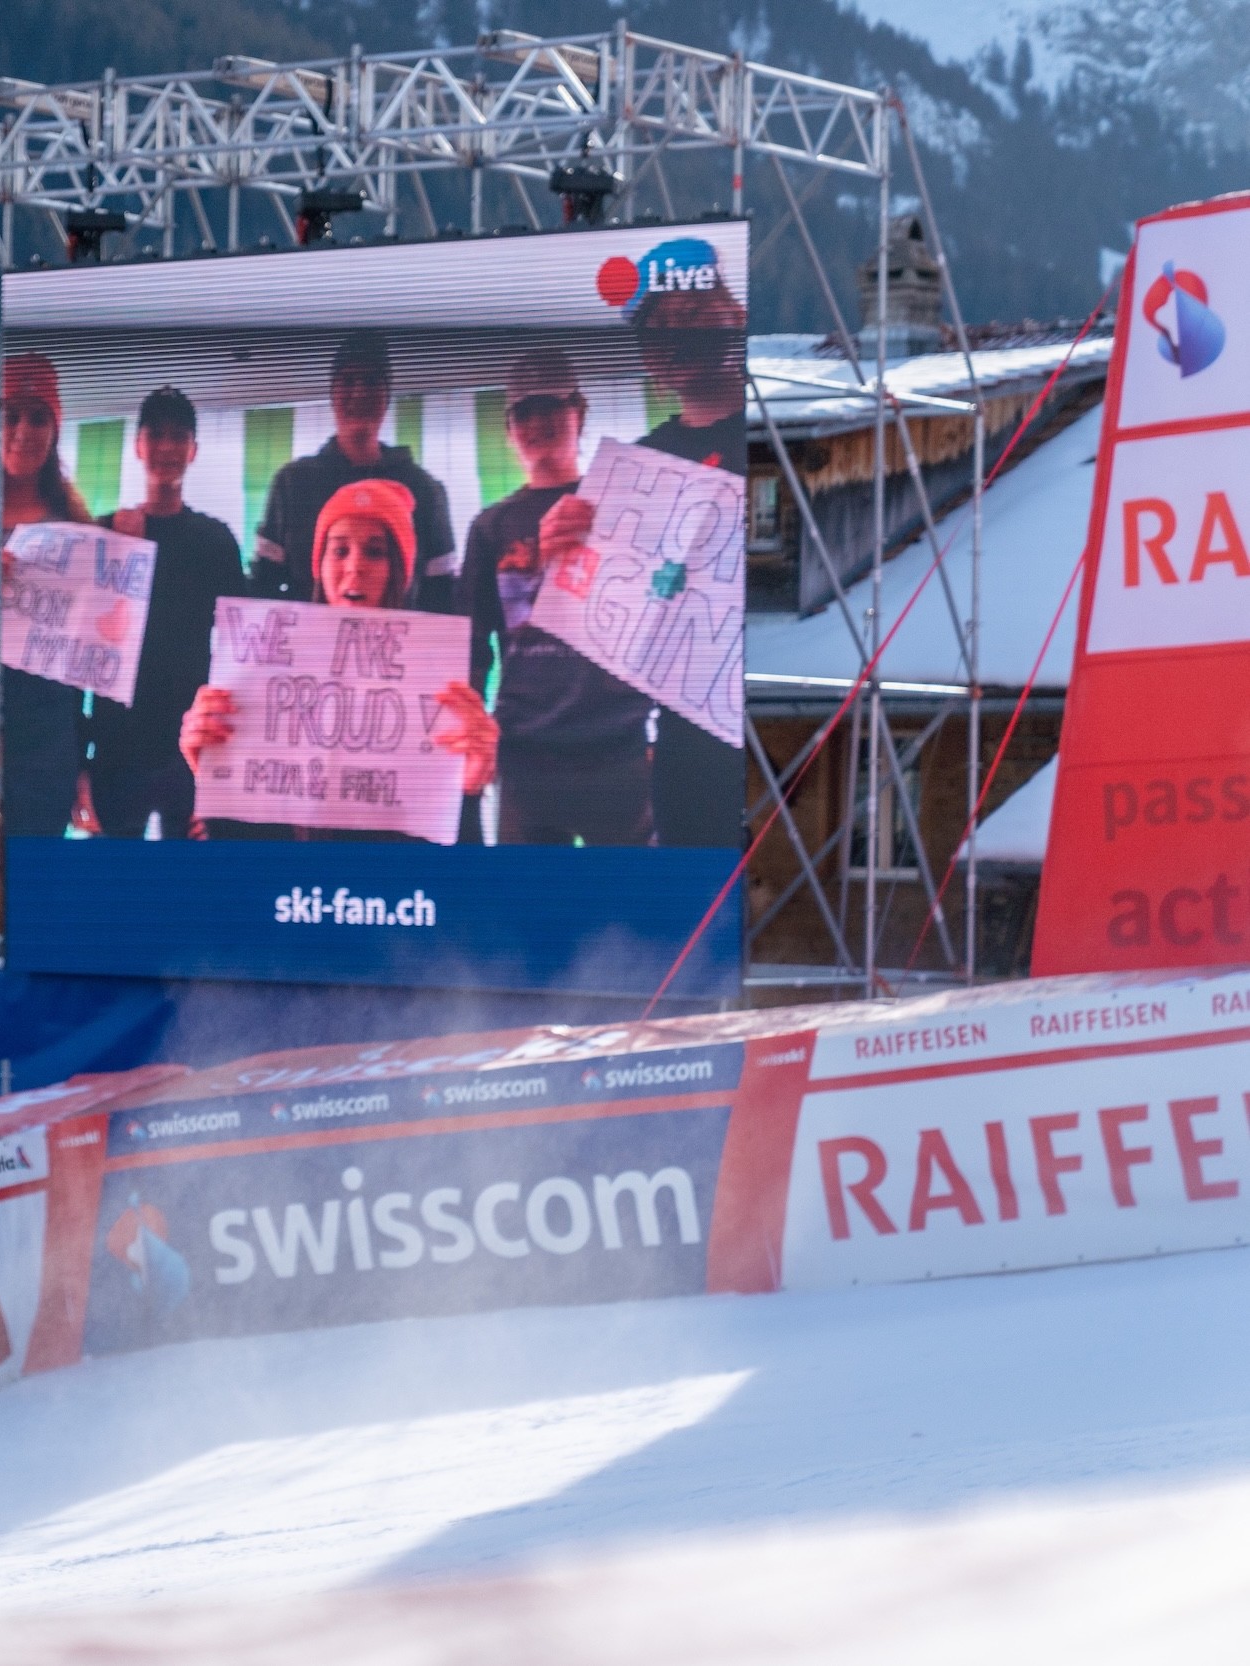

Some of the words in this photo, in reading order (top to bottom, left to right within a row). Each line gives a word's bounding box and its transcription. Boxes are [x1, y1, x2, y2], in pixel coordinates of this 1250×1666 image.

[648, 258, 716, 292] Live
[1121, 490, 1250, 588] RA
[226, 606, 298, 667] WE
[330, 617, 409, 680] ARE
[264, 675, 407, 754] PROUD
[1103, 775, 1250, 842] pass
[274, 886, 436, 927] ski-fan.ch
[855, 1023, 988, 1059] RAIFFEISEN
[1031, 1002, 1168, 1038] RAIFFEISEN
[147, 1111, 240, 1139] swisscom
[291, 1094, 390, 1121] swisscom
[443, 1077, 547, 1105] swisscom
[605, 1060, 713, 1089] swisscom
[817, 1091, 1250, 1241] RAIFFE
[209, 1166, 702, 1286] swisscom
